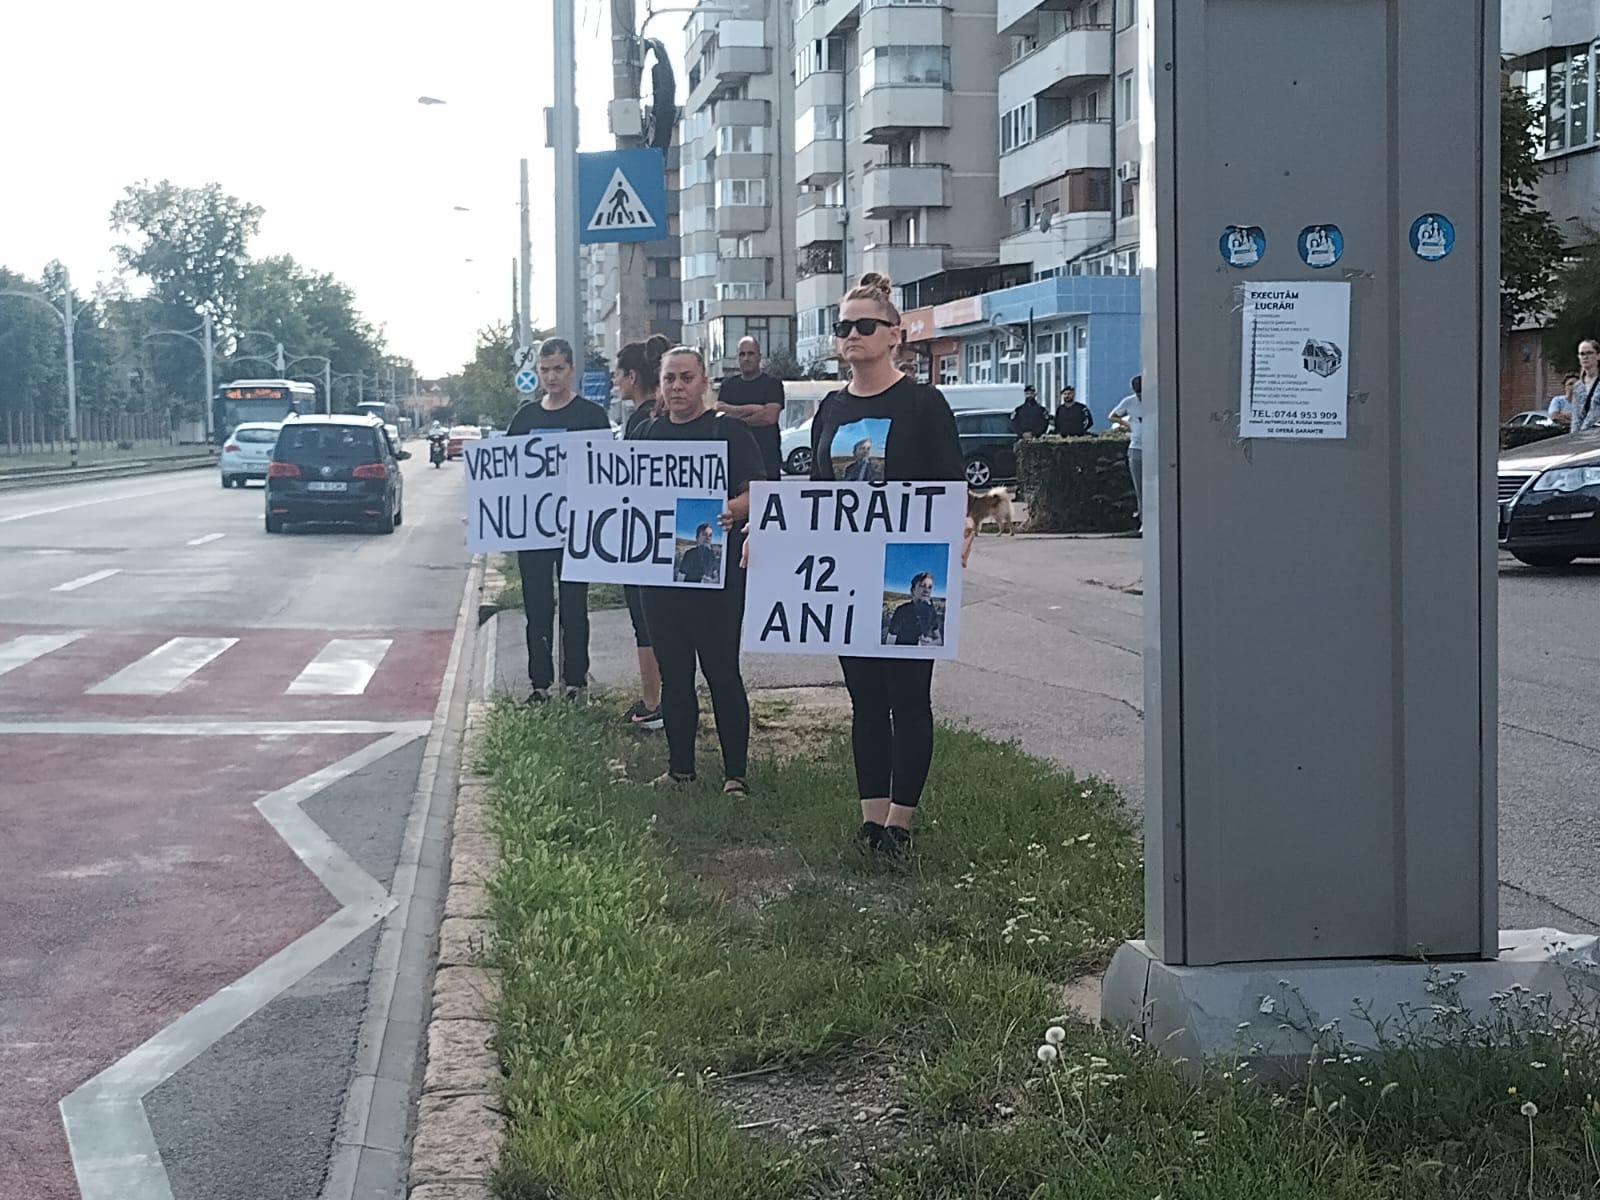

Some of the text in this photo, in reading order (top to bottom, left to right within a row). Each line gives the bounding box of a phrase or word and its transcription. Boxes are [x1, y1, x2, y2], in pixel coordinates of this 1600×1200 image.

[1251, 290, 1299, 299] EXECUTĂM
[1255, 301, 1294, 310] LUCRĂRI
[1300, 411, 1317, 419] 953
[1320, 411, 1338, 419] 909
[465, 444, 518, 481] VREM
[479, 494, 527, 540] NU
[759, 482, 946, 532] A TRĂIT
[568, 496, 674, 564] UCIDE
[795, 555, 839, 592] 12
[760, 589, 855, 645] ANI
